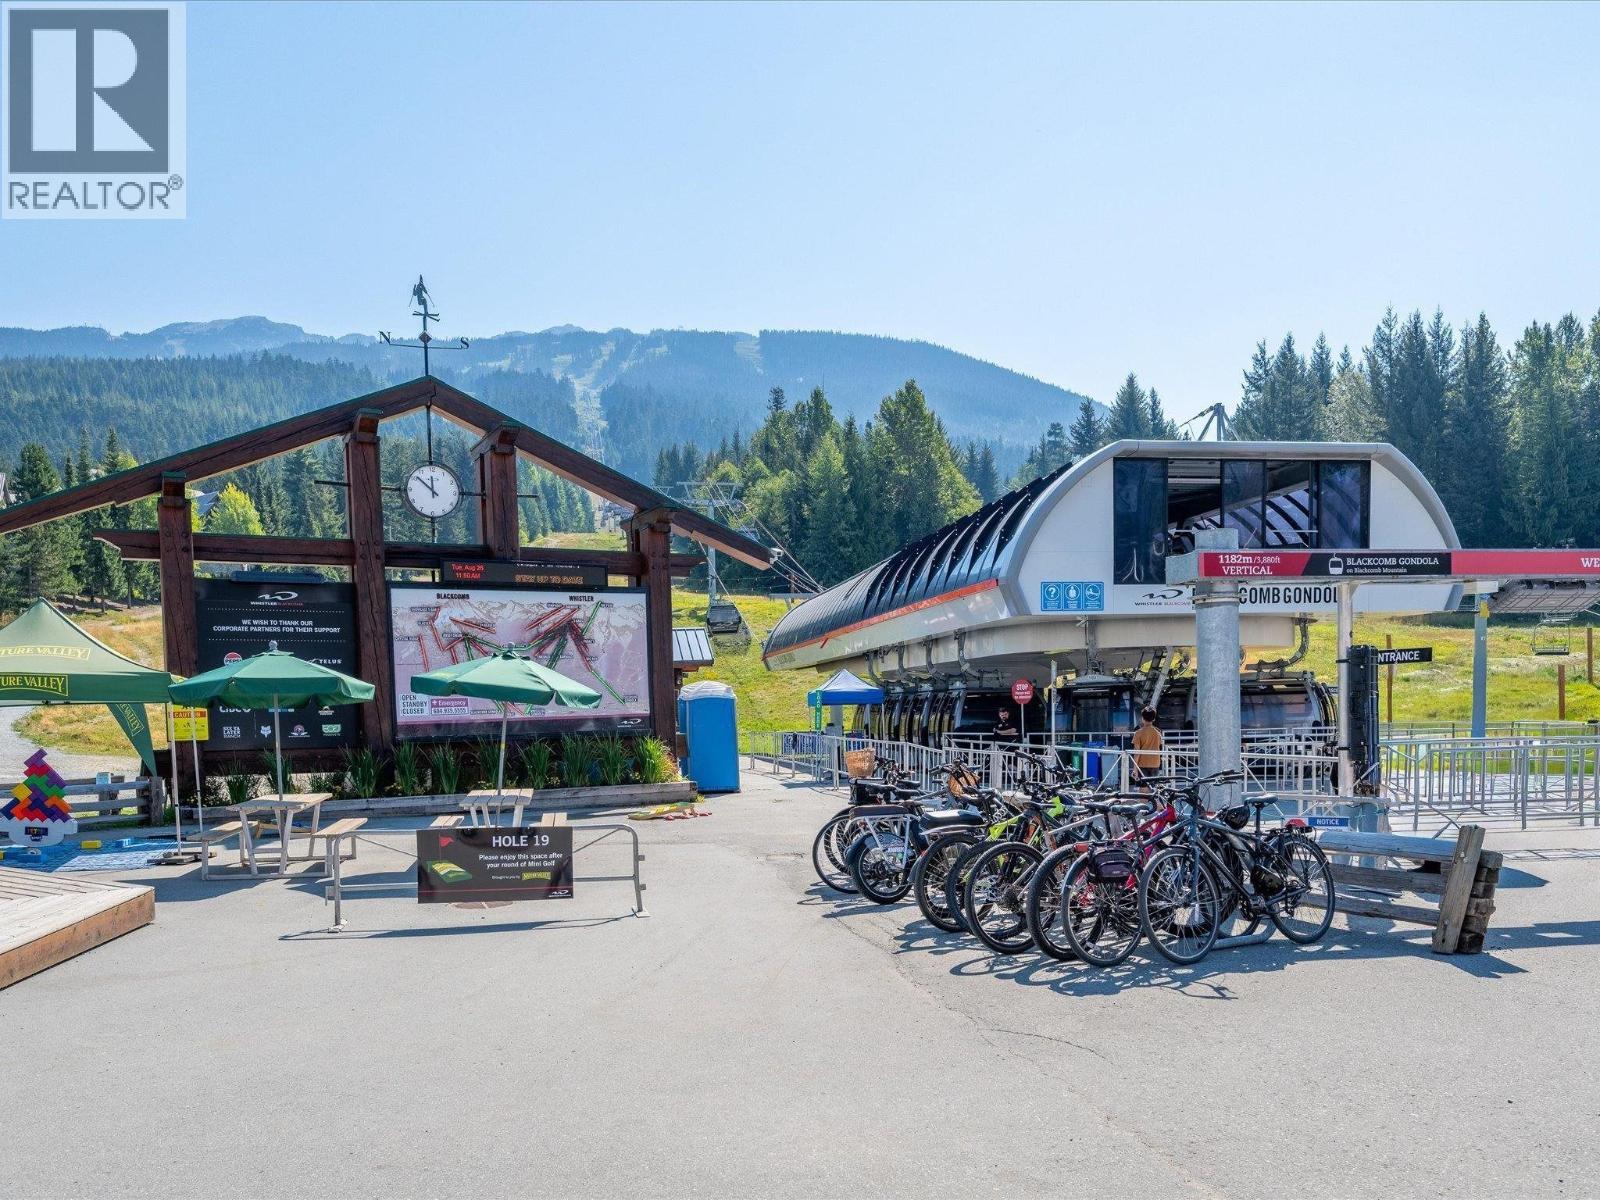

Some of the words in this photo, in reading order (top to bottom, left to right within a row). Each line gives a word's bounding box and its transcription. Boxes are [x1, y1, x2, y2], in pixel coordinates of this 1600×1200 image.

[379, 331, 391, 345] N
[460, 336, 469, 349] S
[1218, 554, 1253, 564] 1182m
[1346, 557, 1397, 566] BLACKCOMB
[1398, 557, 1440, 565] GONDOLA
[1580, 557, 1600, 568] WE
[1222, 565, 1273, 575] VERTICAL
[1283, 587, 1338, 604] GONDOL
[0, 647, 33, 655] TURE
[37, 647, 86, 659] VALLEY
[1378, 650, 1420, 662] NTRANCE
[1, 676, 23, 686] URE
[24, 676, 64, 692] VALLEY
[1016, 683, 1029, 691] STOP
[1316, 818, 1339, 826] NOTICE
[492, 835, 528, 847] HOLE
[533, 834, 550, 846] 19
[500, 854, 516, 862] enjoy
